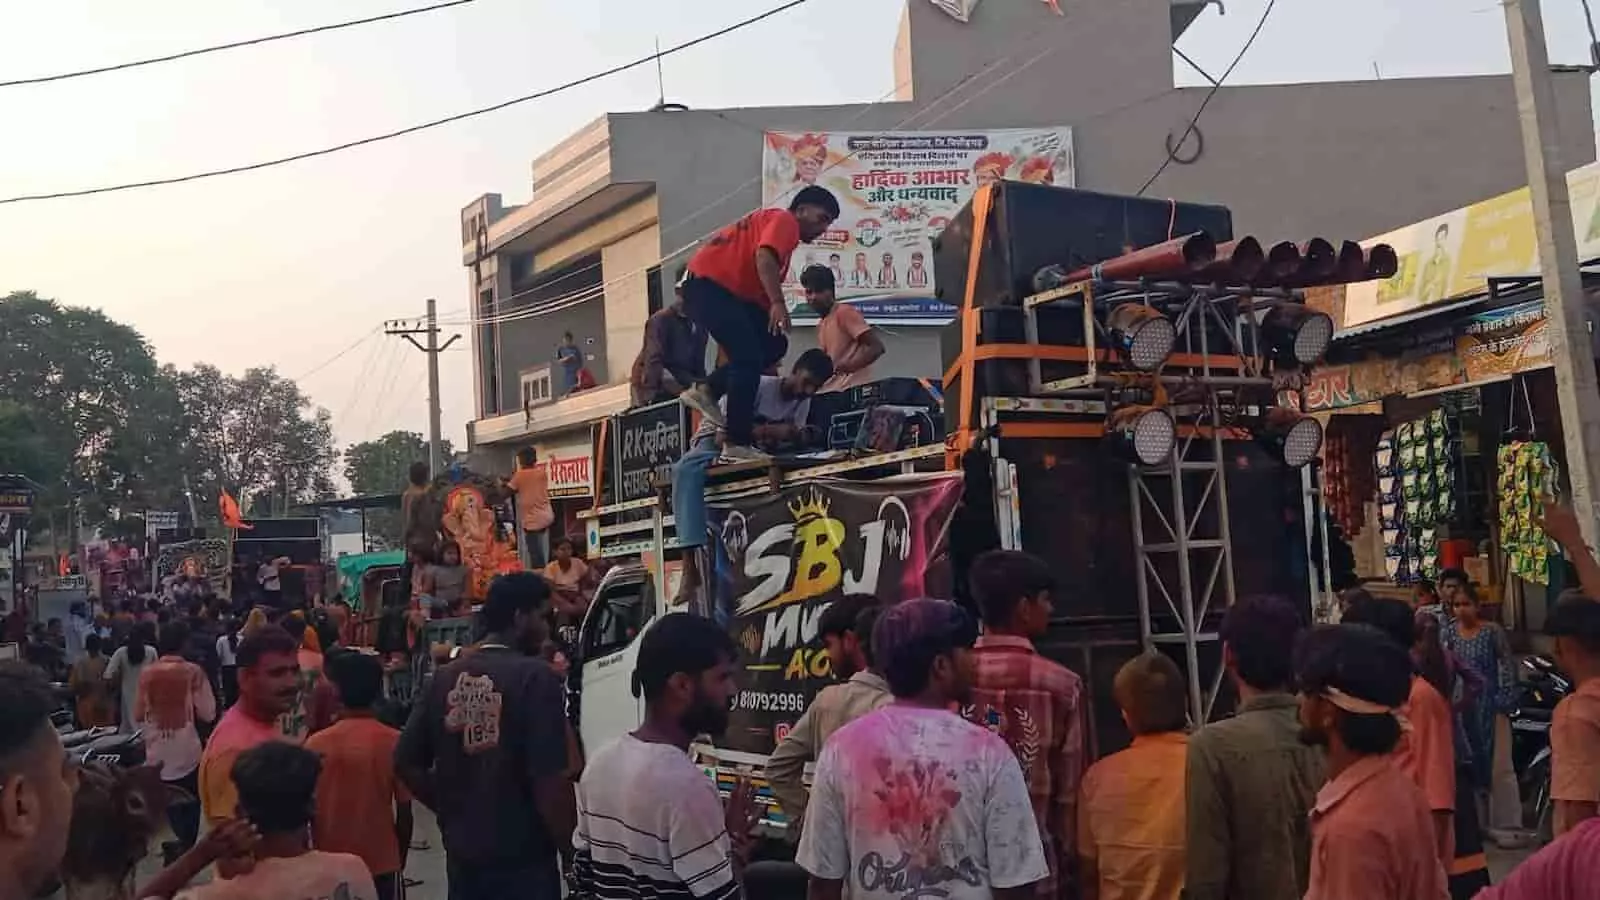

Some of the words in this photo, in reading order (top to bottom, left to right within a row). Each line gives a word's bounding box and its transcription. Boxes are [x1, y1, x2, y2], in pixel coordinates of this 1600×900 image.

[851, 169, 908, 190] हार्दिक
[912, 169, 970, 185] आभार
[868, 187, 894, 203] और
[898, 186, 959, 203] धन्यवाद
[736, 514, 886, 616] SBJ
[761, 602, 832, 657] MU
